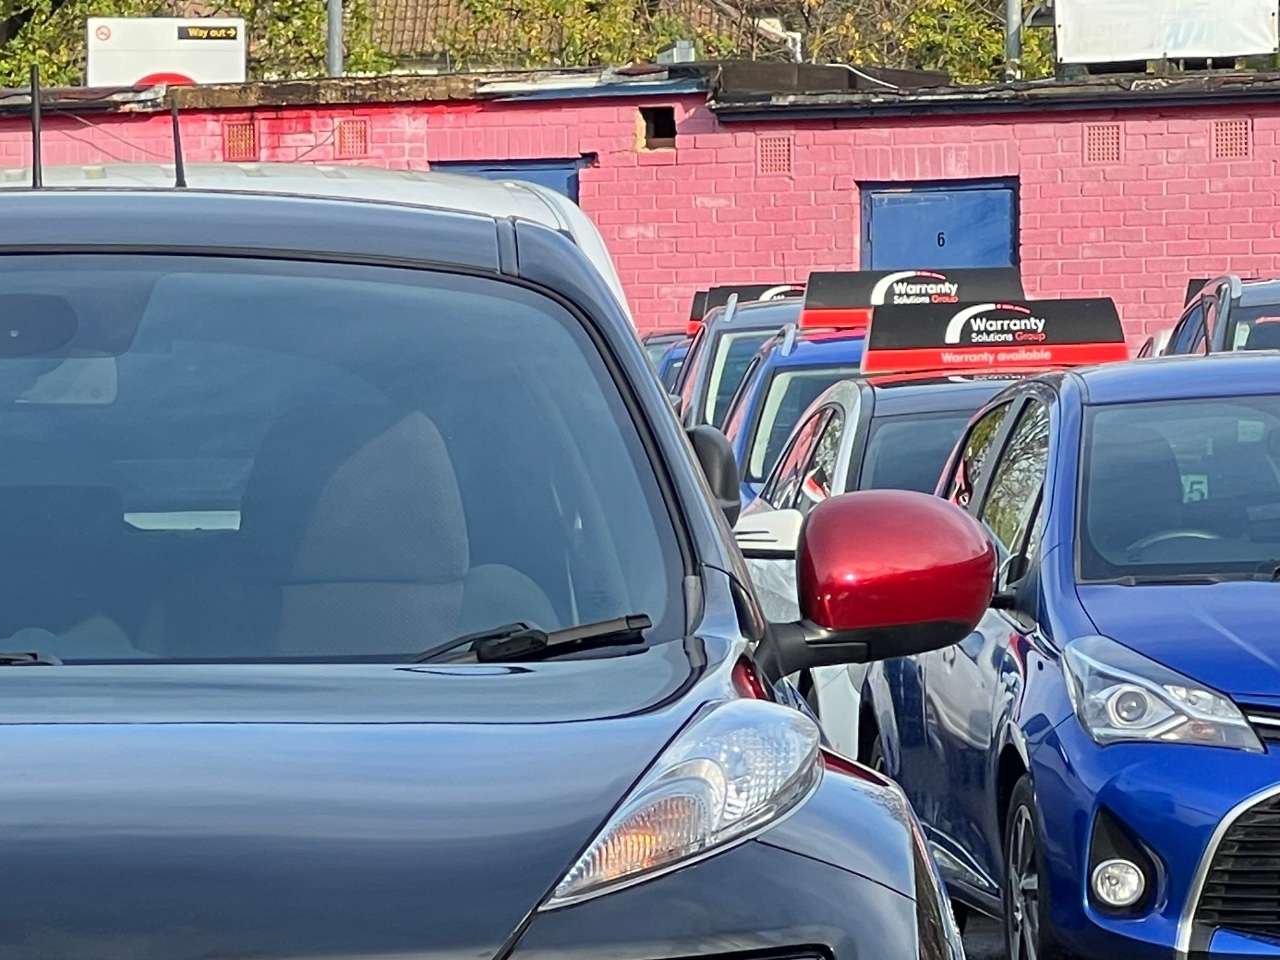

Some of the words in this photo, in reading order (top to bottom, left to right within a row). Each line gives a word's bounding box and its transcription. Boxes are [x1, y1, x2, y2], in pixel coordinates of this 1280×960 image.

[187, 27, 209, 39] Way
[209, 28, 226, 37] out
[936, 231, 945, 248] 6
[892, 281, 959, 296] Warranty
[893, 295, 930, 304] Solutions
[931, 294, 959, 303] Group
[970, 317, 1046, 333] Warranty
[971, 332, 1014, 342] Solutions
[1015, 331, 1046, 342] Group
[941, 352, 995, 364] Warranty
[997, 350, 1052, 361] available
